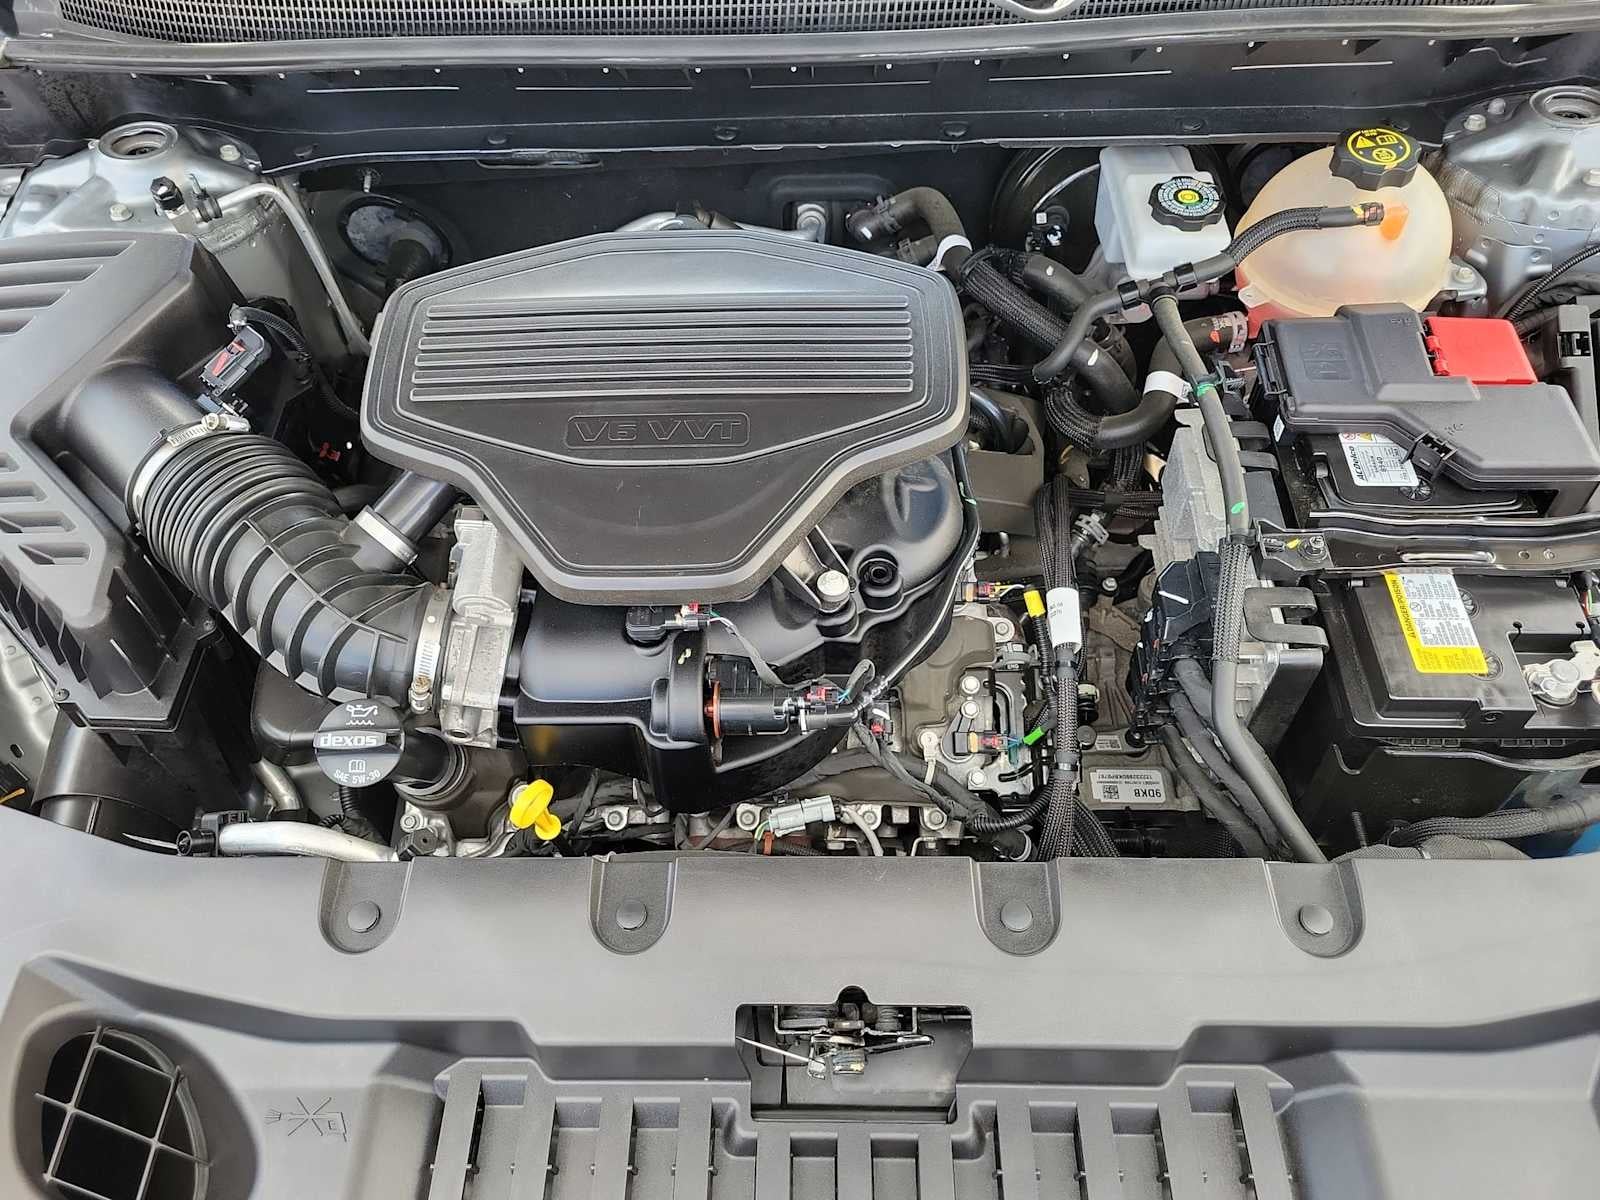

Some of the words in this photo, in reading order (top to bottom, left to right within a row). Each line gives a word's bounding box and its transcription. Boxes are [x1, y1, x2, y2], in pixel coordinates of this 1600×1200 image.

[575, 421, 636, 441] V6
[648, 419, 741, 440] VVT
[1349, 446, 1365, 480] ACDelco
[320, 733, 377, 747] dexos
[334, 769, 350, 782] SAE
[352, 769, 381, 784] 5W-30
[1134, 788, 1162, 798] 9DKB
